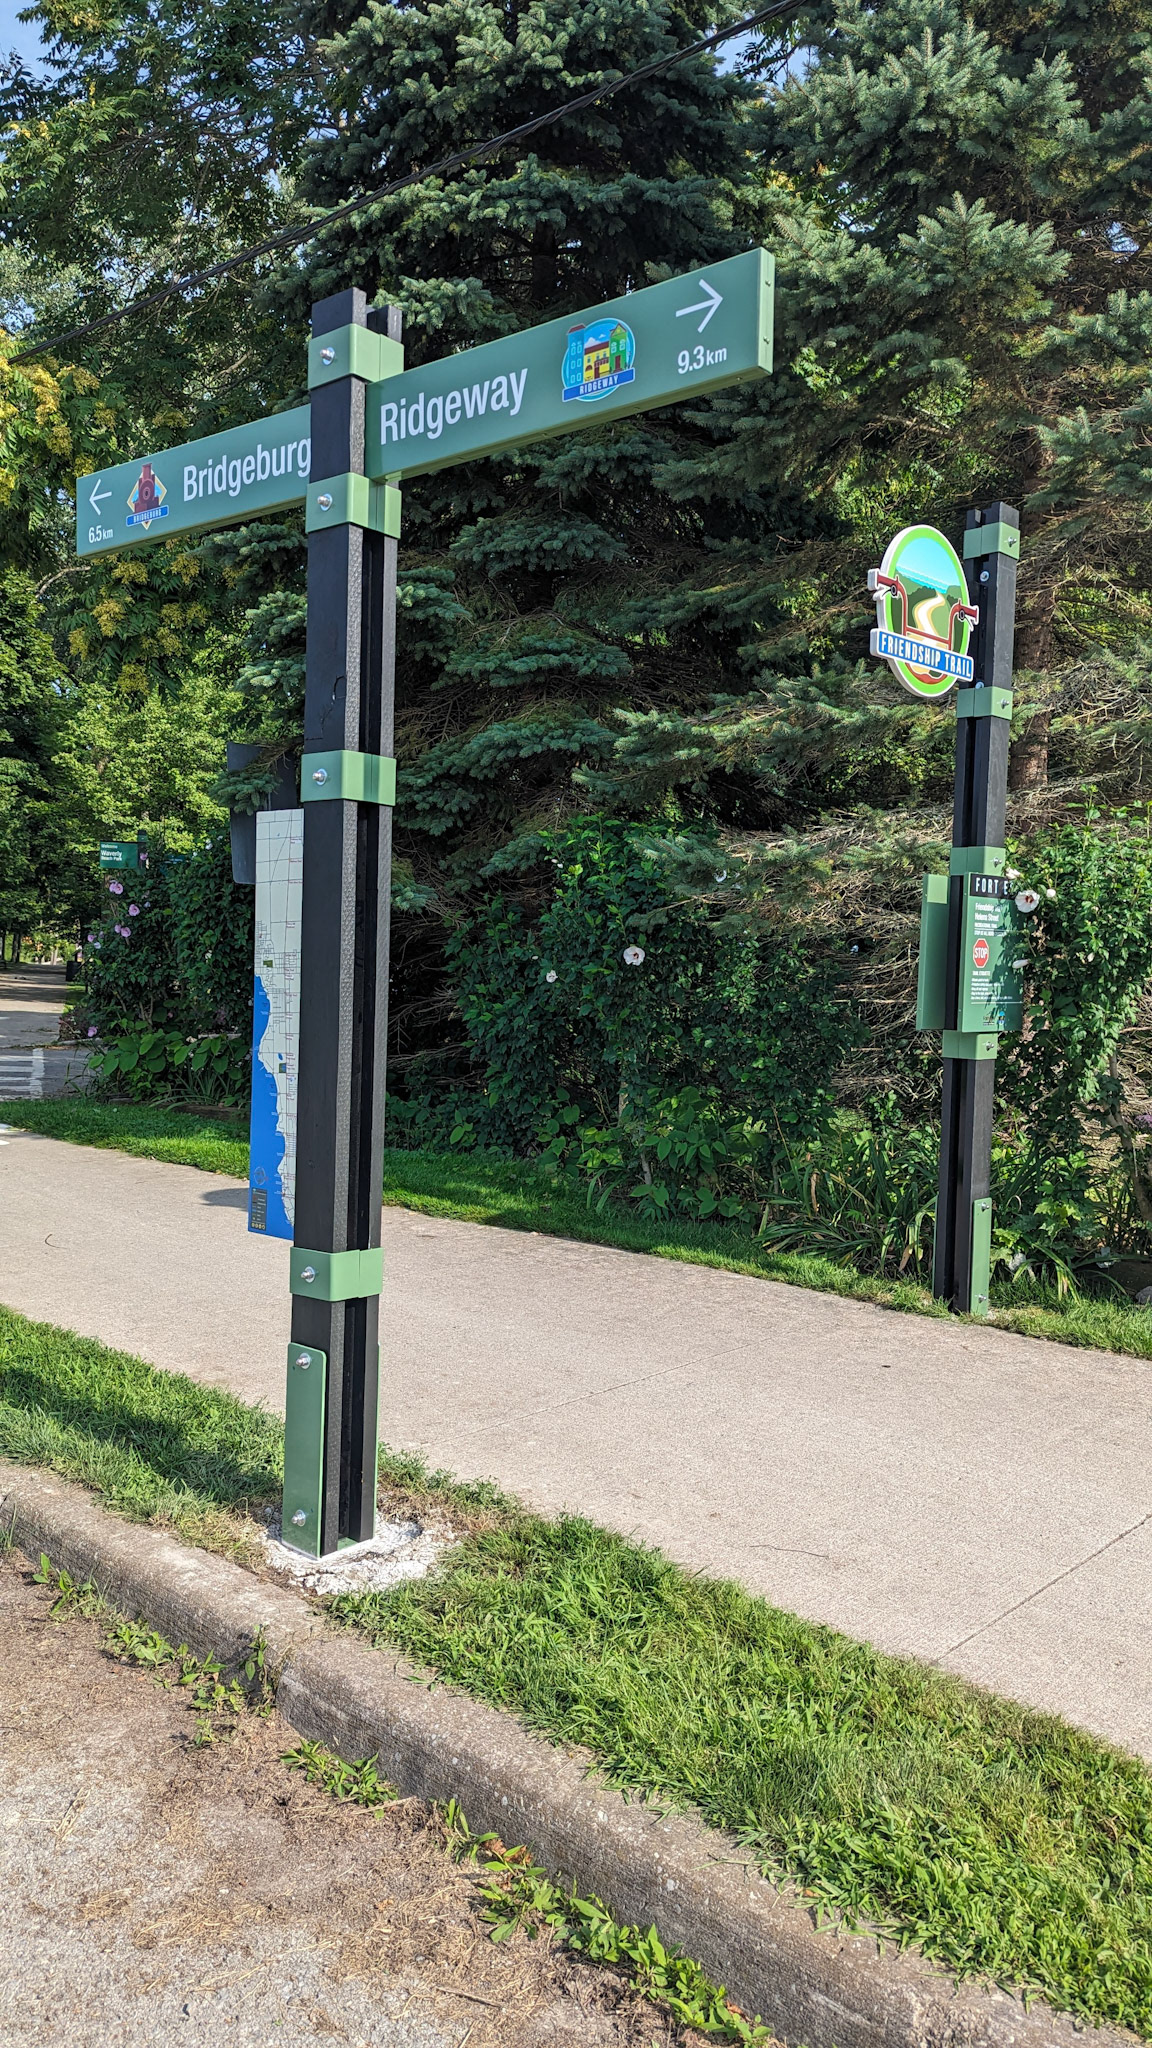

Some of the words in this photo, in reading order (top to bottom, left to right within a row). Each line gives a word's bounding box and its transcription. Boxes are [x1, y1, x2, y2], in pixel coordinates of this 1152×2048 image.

[579, 374, 619, 395] RIDGEWAY
[380, 368, 528, 446] Ridgeway
[183, 437, 311, 502] Bridgeburg
[133, 508, 162, 523] BRIDGEBURG
[881, 633, 941, 668] FRIENDSHIP
[945, 653, 971, 678] TRAIL
[101, 850, 122, 858] Waverly
[975, 877, 999, 894] FORT
[988, 913, 999, 922] Street
[974, 947, 988, 959] STOP
